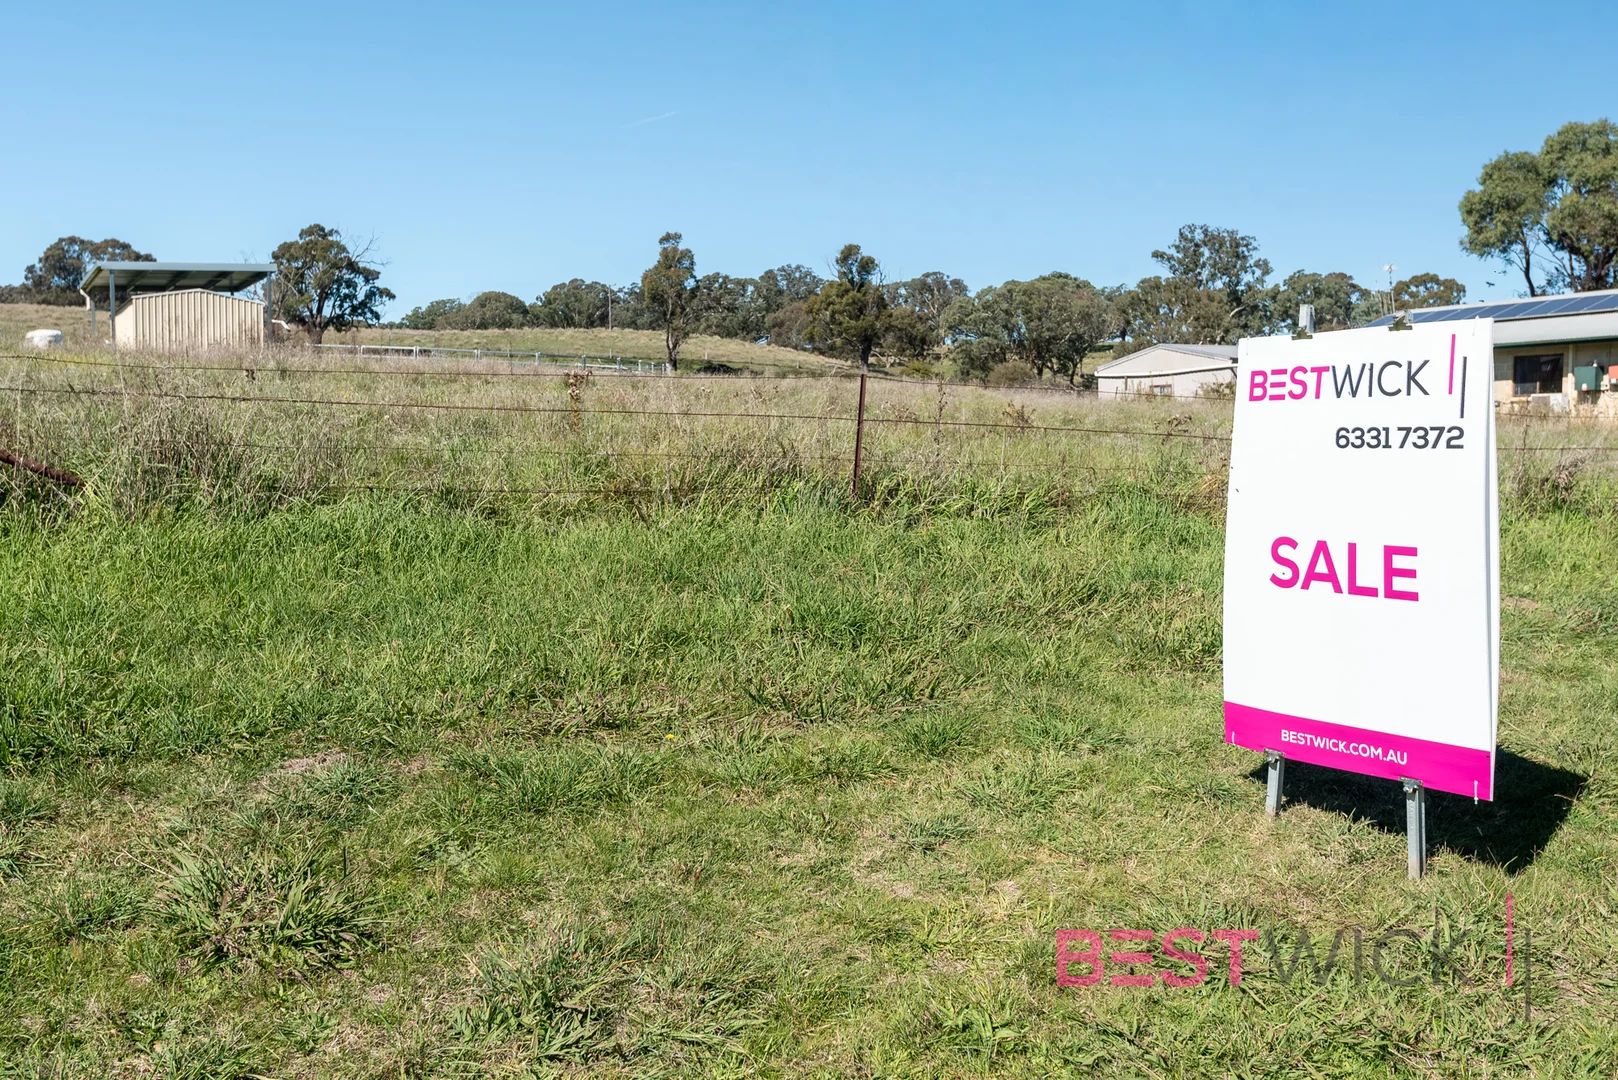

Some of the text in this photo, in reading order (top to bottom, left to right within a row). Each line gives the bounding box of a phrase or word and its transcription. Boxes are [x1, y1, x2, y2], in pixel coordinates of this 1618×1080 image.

[1249, 359, 1430, 401] BESTWICK
[1269, 536, 1419, 602] SALE
[1281, 729, 1408, 765] BESTWICK.COM.AU
